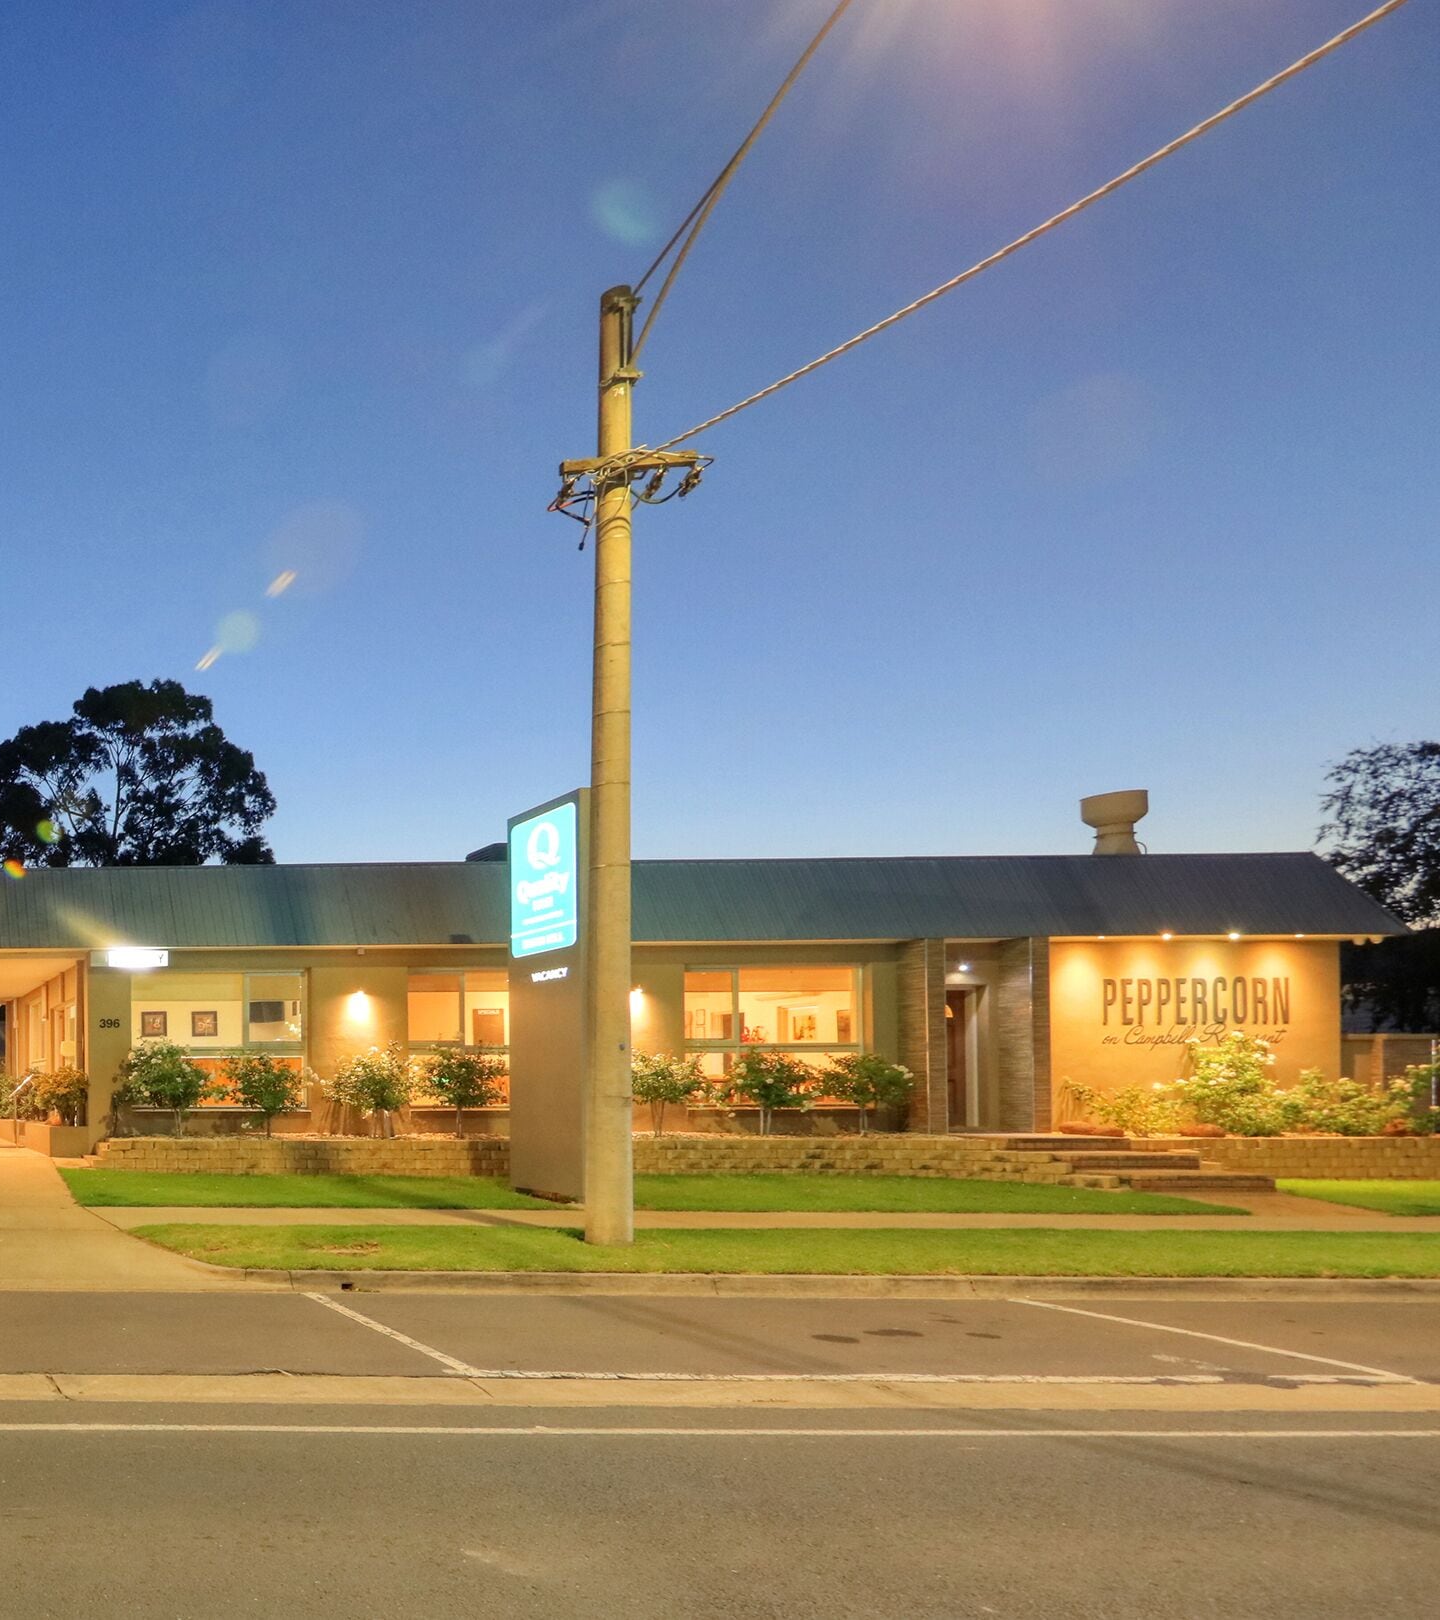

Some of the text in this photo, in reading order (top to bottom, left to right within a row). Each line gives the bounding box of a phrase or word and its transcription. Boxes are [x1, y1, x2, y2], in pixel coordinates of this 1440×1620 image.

[527, 822, 561, 870] Q
[1102, 976, 1290, 1026] PEPPERCORN
[99, 1018, 120, 1028] 396
[1102, 1036, 1120, 1044] on
[1124, 1025, 1196, 1051] Campbell
